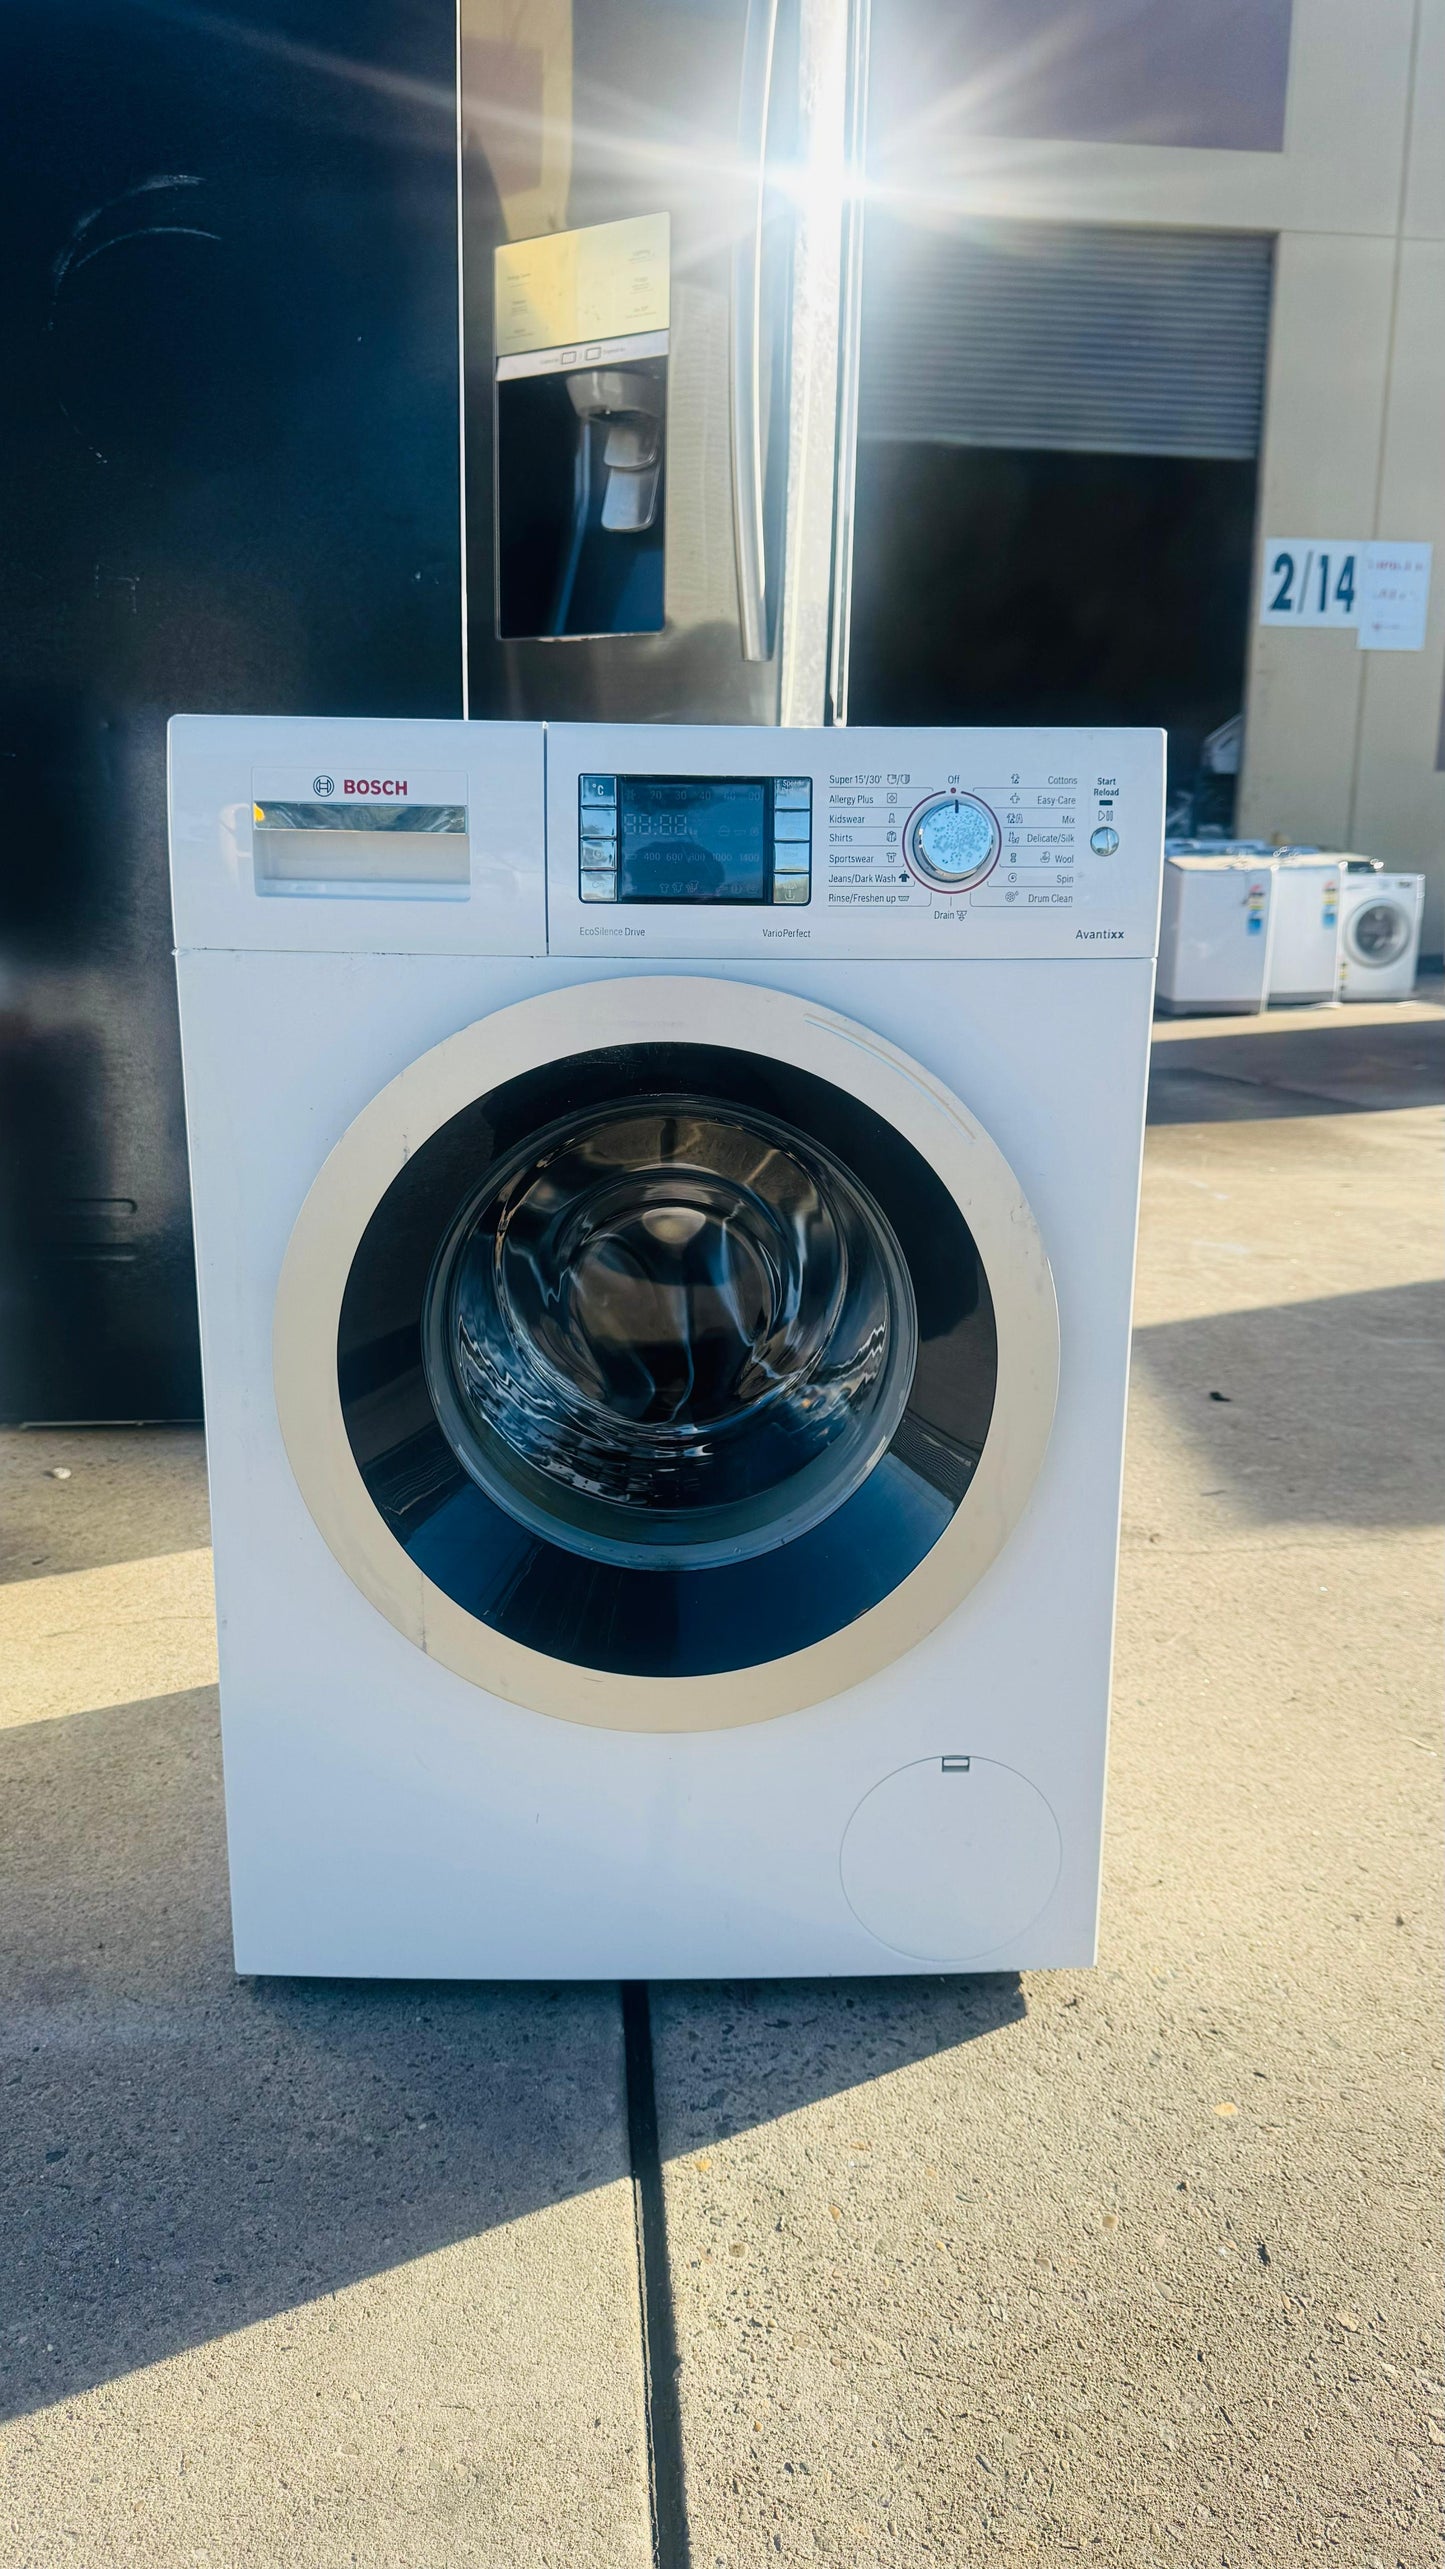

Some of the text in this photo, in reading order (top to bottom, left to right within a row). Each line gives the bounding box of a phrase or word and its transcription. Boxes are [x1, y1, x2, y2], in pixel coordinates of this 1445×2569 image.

[1270, 551, 1356, 613] 2/14
[829, 774, 853, 785] Super
[947, 774, 960, 784] Off
[1047, 775, 1078, 785] Cottons
[1097, 777, 1116, 786] Start
[343, 779, 408, 796] BOSCH
[592, 783, 604, 796] °C
[1093, 788, 1119, 797] Reload
[829, 795, 874, 805] Allergy Plus
[1037, 795, 1076, 806] Easy Care
[829, 814, 865, 824] Kidswear
[1061, 815, 1075, 824] Mix
[829, 833, 853, 842] Shirts
[1027, 833, 1075, 843] Delicate/Silk
[829, 854, 874, 864] Sportswear
[1055, 854, 1074, 864] Wool
[828, 873, 896, 884] Jeans/Dark Wash
[1056, 874, 1074, 885] Spin
[828, 893, 896, 905] Rinse/Freshen up
[1028, 893, 1073, 903] Drum Clean
[934, 910, 955, 920] Drain
[579, 927, 645, 937] EcoSilence Drive
[762, 928, 811, 938] VarioPerfect
[1075, 929, 1125, 939] Avantixx
